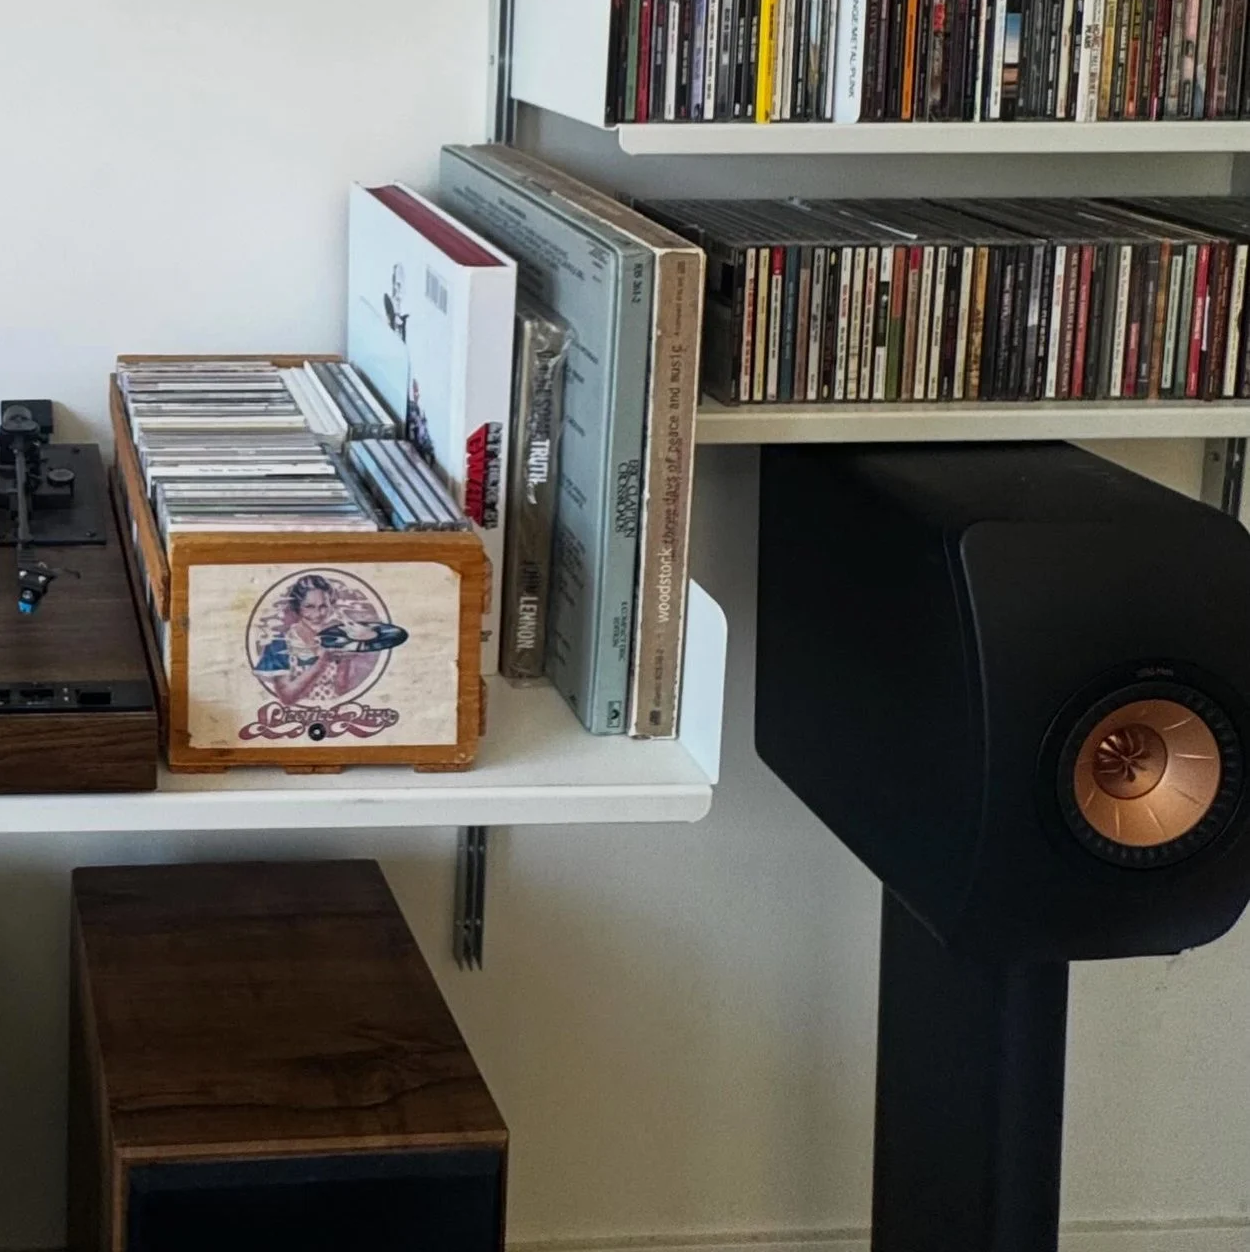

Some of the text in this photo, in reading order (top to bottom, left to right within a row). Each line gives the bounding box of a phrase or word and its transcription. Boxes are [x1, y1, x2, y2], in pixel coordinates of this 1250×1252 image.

[670, 344, 687, 383] music
[667, 387, 681, 410] and
[488, 422, 503, 451] LET
[667, 415, 686, 453] peace
[486, 456, 502, 506] THERE
[614, 462, 628, 533] CROSSROADS
[624, 459, 638, 538] ERIC CLAPTON
[662, 476, 680, 505] days
[656, 546, 674, 623] woodstock
[516, 595, 538, 653] LENNON.
[612, 616, 620, 647] EDITION
[619, 606, 627, 645] COMPACT
